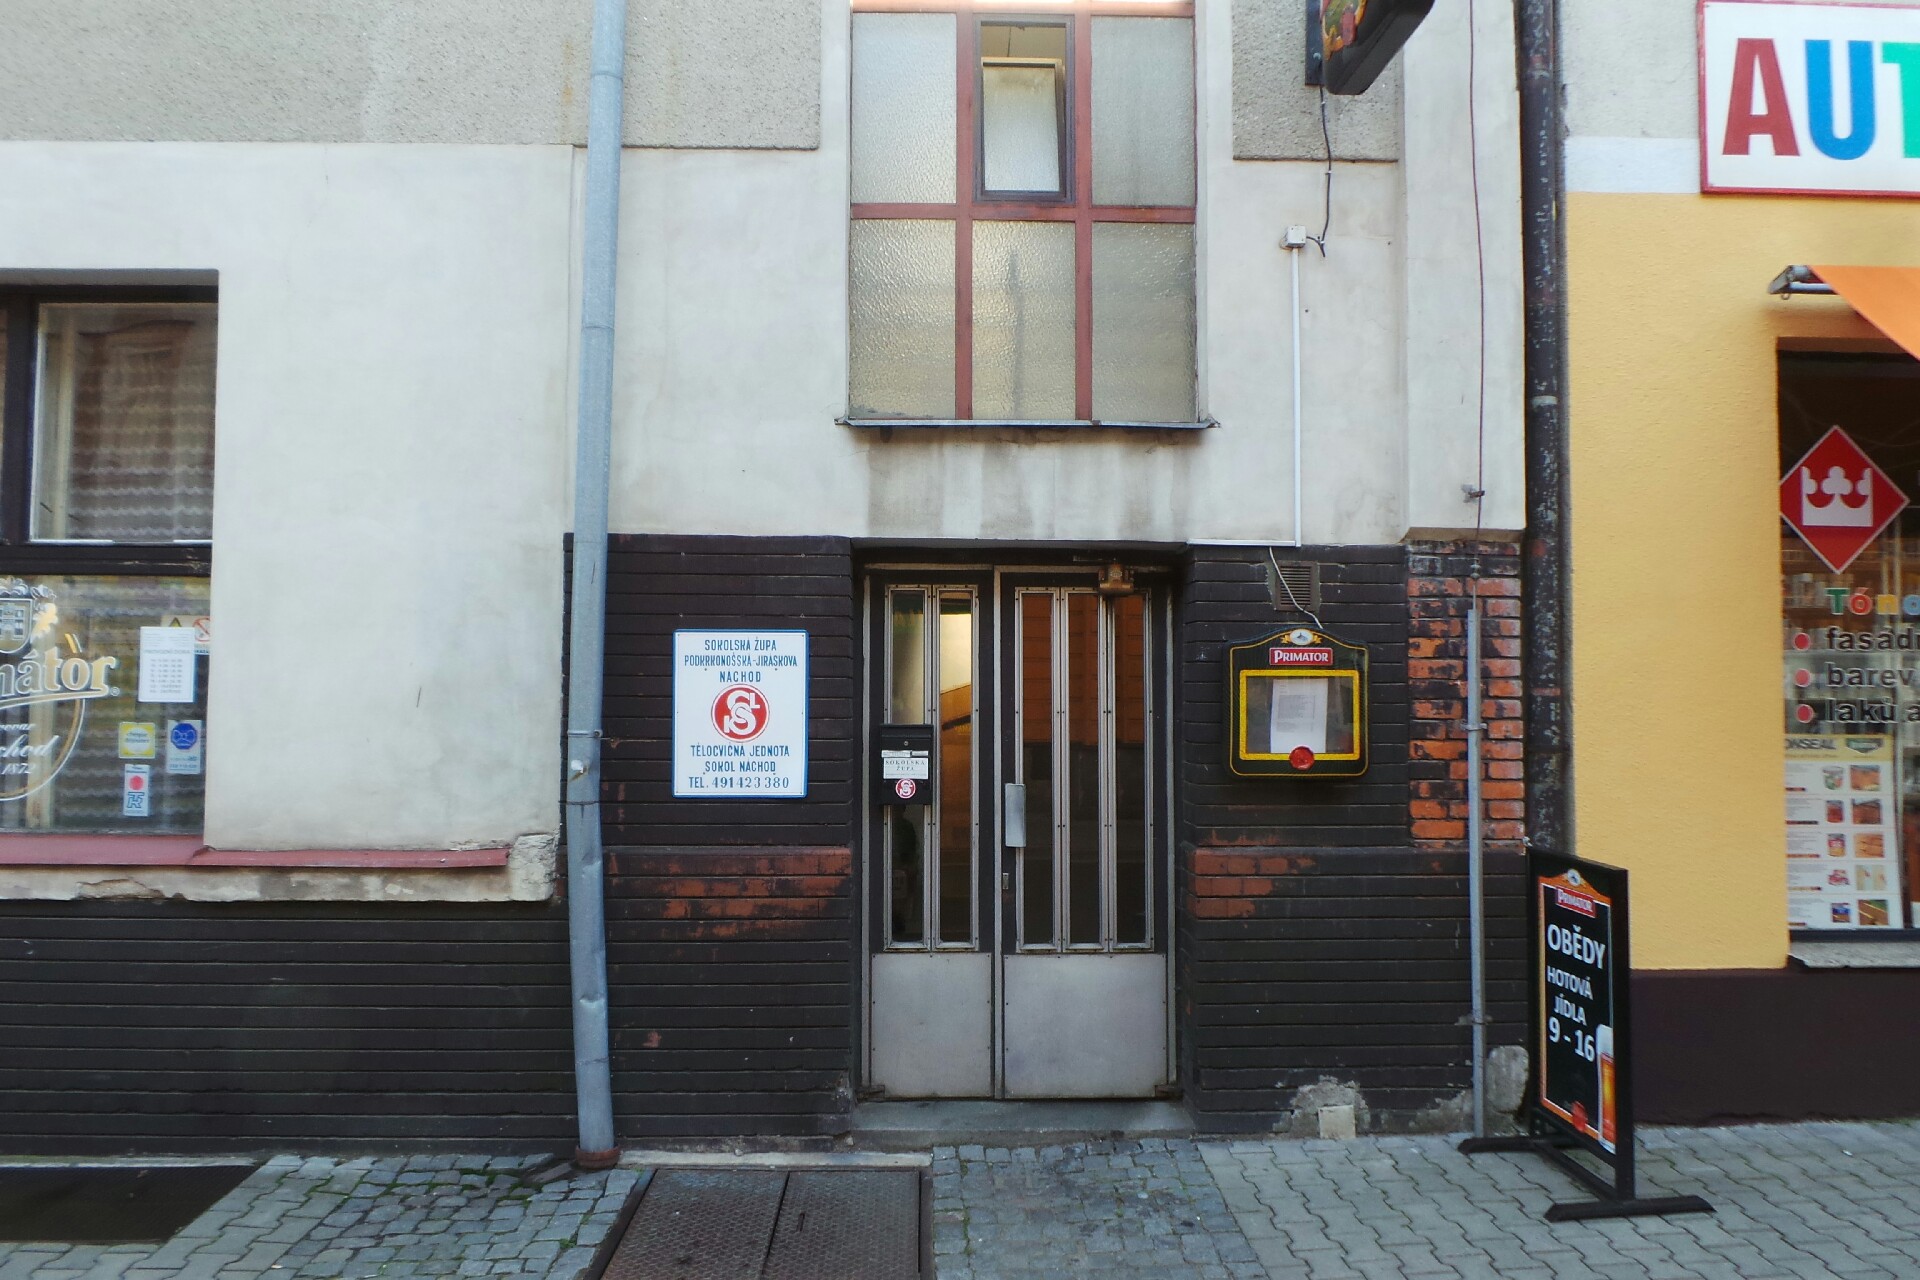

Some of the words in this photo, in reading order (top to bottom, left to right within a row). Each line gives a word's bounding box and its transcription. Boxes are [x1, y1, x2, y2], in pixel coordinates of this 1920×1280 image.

[704, 637, 751, 651] SOKOLSKÁ
[754, 636, 777, 651] ŽUPA
[1826, 626, 1920, 651] fasád
[1274, 650, 1329, 663] PRIMATOR
[1825, 662, 1915, 688] barev
[1826, 697, 1899, 724] laků
[691, 742, 746, 757] TĚLOCVIČNÁ
[749, 745, 790, 757] JEDNOTA
[705, 761, 735, 772] SOKOL
[739, 758, 776, 772] NÁCHOD
[689, 776, 709, 788] TEL.
[1547, 923, 1606, 969] OBĚDY
[1547, 965, 1594, 1001] HOTOVÁ
[1554, 993, 1588, 1026] JÍDLA
